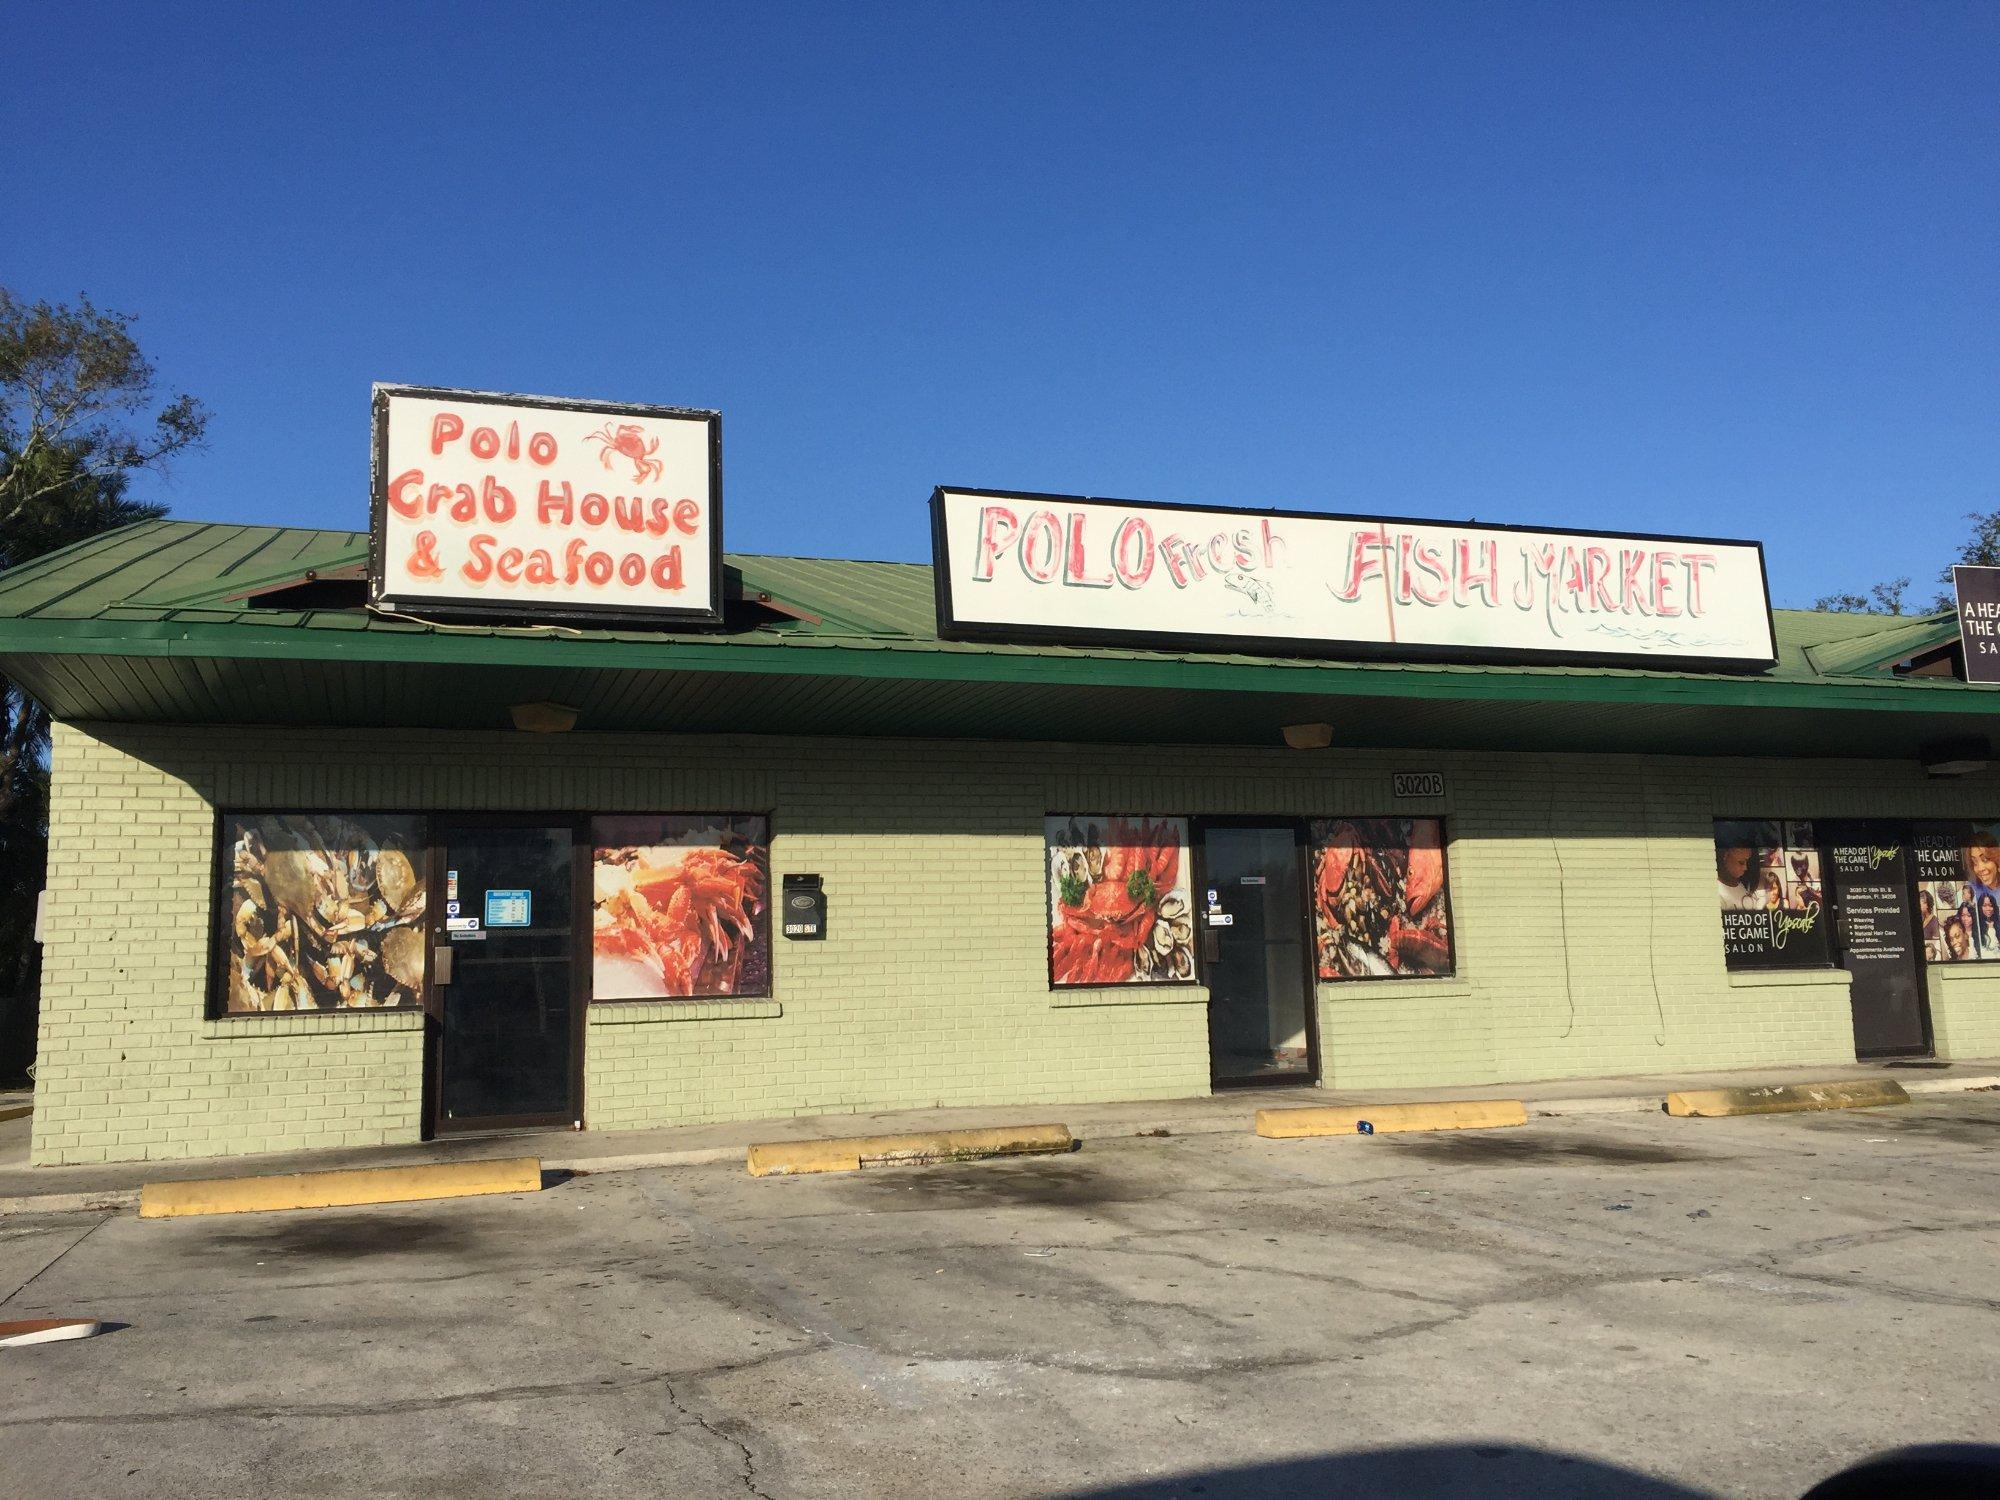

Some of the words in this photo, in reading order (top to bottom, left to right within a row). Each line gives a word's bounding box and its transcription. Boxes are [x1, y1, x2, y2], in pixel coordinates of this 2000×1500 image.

[430, 413, 558, 466] Polo
[388, 469, 517, 524] Crab
[537, 480, 699, 535] House
[406, 530, 446, 578] &
[462, 534, 686, 590] Seafood
[972, 506, 1156, 590] POLO
[1325, 530, 1501, 608] FISH
[1513, 541, 1717, 638] MARKET
[1965, 602, 1975, 617] A
[1966, 620, 1994, 636] THE
[1396, 775, 1442, 795] 3020B
[1848, 856, 1868, 864] GAME
[1914, 850, 1931, 862] HE
[1932, 850, 1960, 862] GAME
[1920, 866, 1955, 877] SALON
[1873, 906, 1900, 914] Provided
[1724, 914, 1752, 926] HEAD
[1754, 914, 1768, 926] OF
[786, 924, 804, 934] 3020
[1738, 928, 1770, 940] GAME
[1725, 943, 1764, 953] SALON
